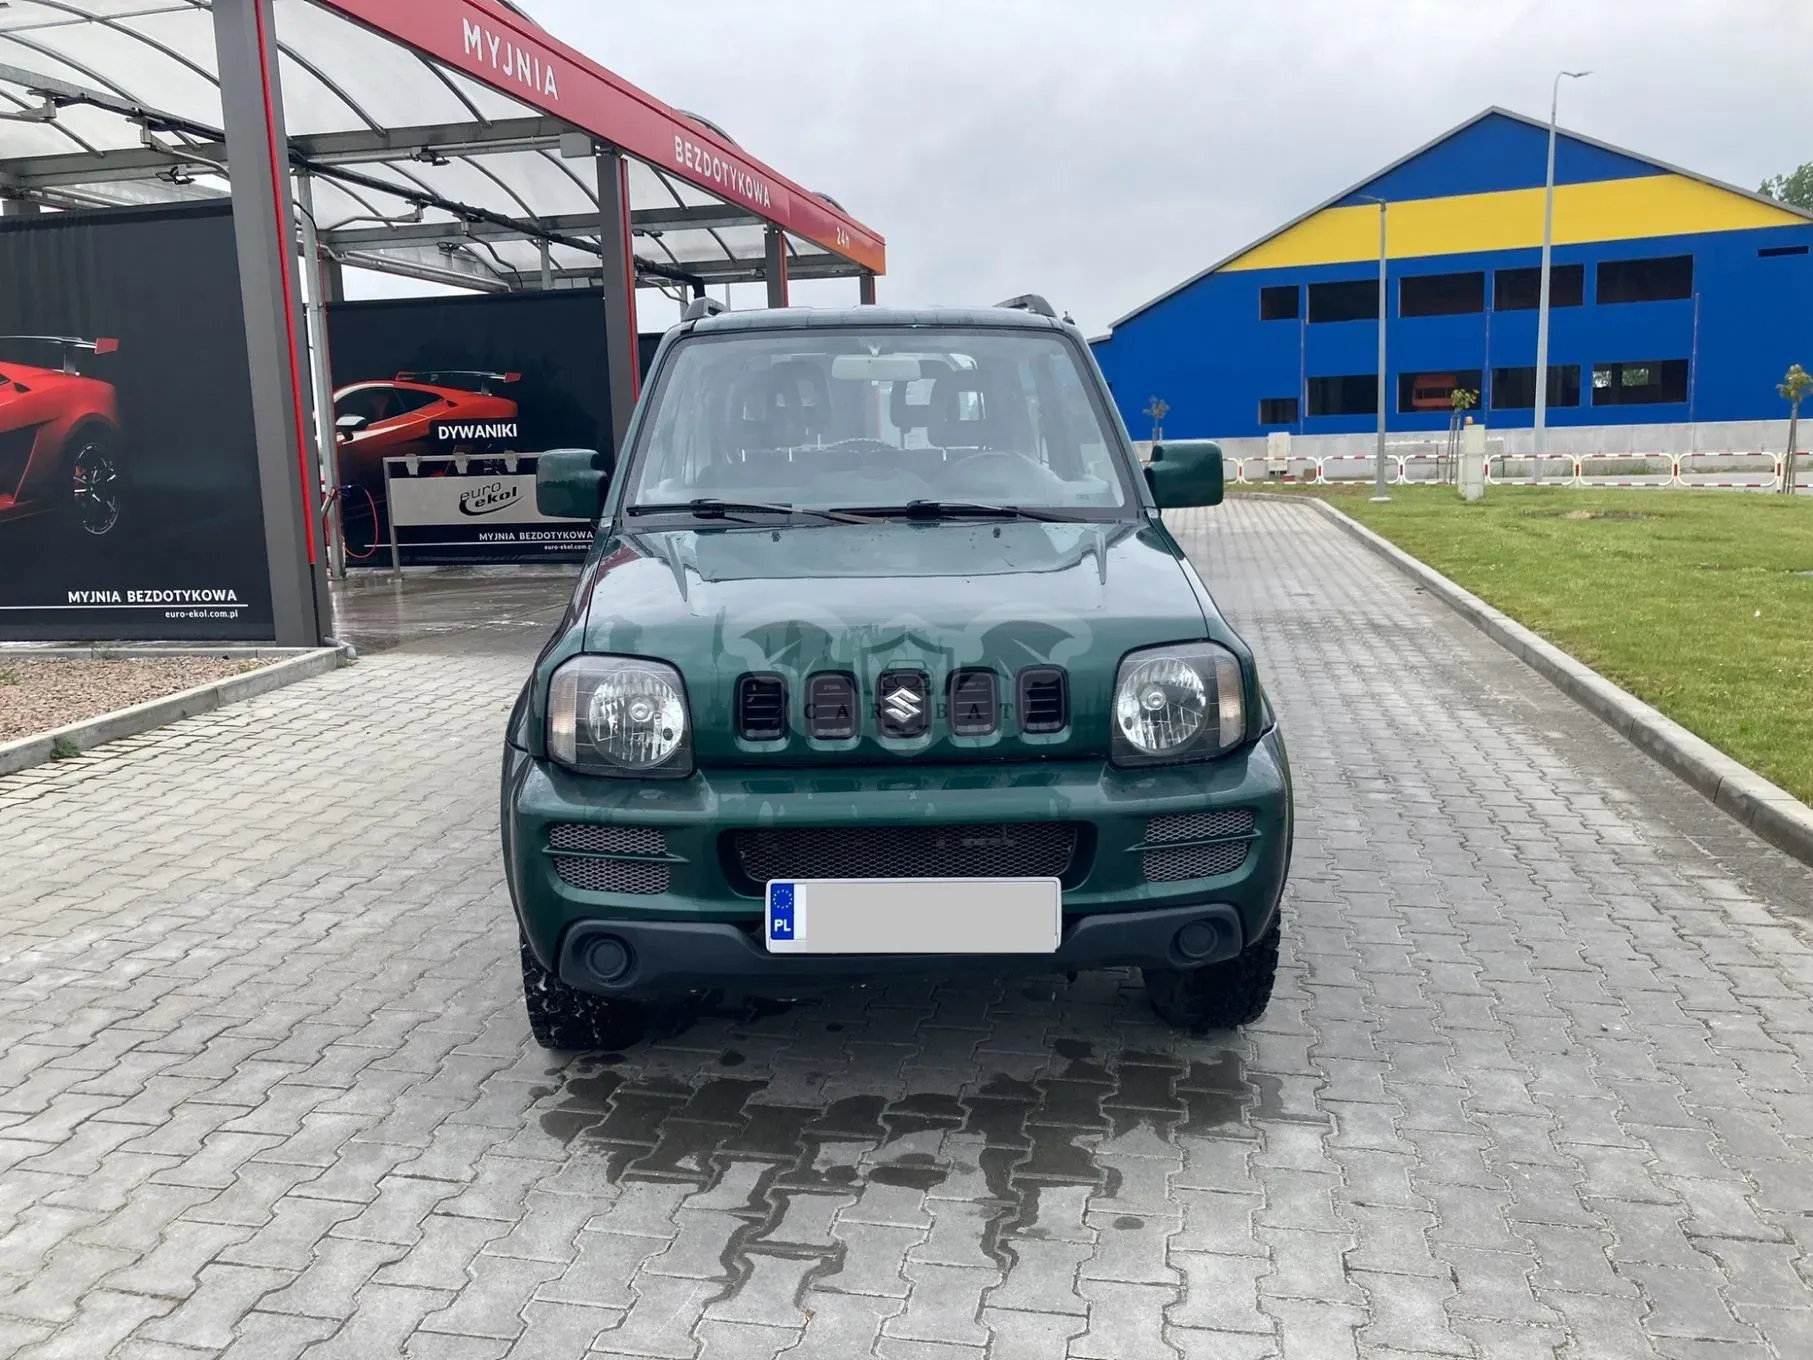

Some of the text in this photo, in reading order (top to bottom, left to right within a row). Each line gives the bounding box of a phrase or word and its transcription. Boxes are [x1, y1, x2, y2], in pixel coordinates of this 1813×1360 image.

[463, 17, 559, 101] MYJNIA
[674, 135, 771, 209] BEZDOTYKOWA
[438, 424, 518, 440] DYWANIKI
[460, 481, 502, 501] euro
[474, 486, 518, 508] ekol
[479, 531, 594, 541] MYJNIA BEZDOTYKOWA
[544, 543, 592, 551] euro-ekol.com.p
[67, 589, 238, 603] MYJNIA BEZDOTYKOWA
[165, 609, 238, 619] euro-ekol.com.pl
[774, 918, 792, 932] PL
